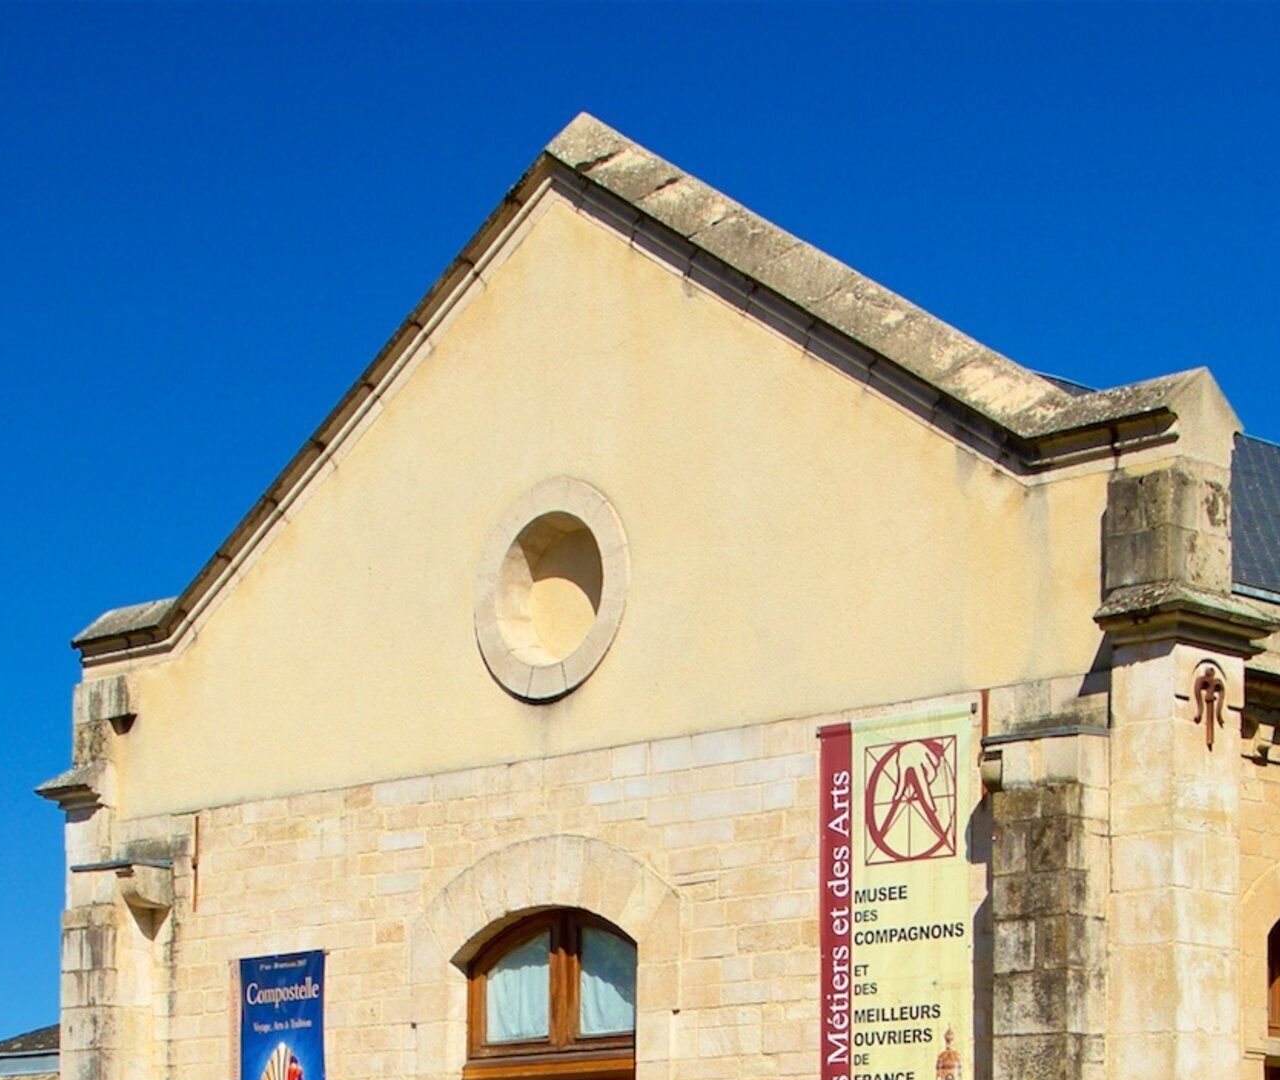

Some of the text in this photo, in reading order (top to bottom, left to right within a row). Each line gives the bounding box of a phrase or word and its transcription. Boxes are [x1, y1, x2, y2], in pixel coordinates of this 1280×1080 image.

[828, 770, 850, 838] Arts
[827, 845, 850, 898] des
[854, 885, 908, 904] MUSEE
[830, 907, 849, 936] et
[854, 909, 878, 923] DES
[854, 922, 965, 945] COMPAGNONS
[854, 964, 869, 977] ET
[246, 976, 320, 1009] Compostelle
[854, 982, 878, 996] DES
[827, 945, 849, 1064] Métiers
[854, 1004, 941, 1023] MEILLEURS
[854, 1028, 933, 1047] OUVRIERS
[854, 1053, 870, 1066] DE
